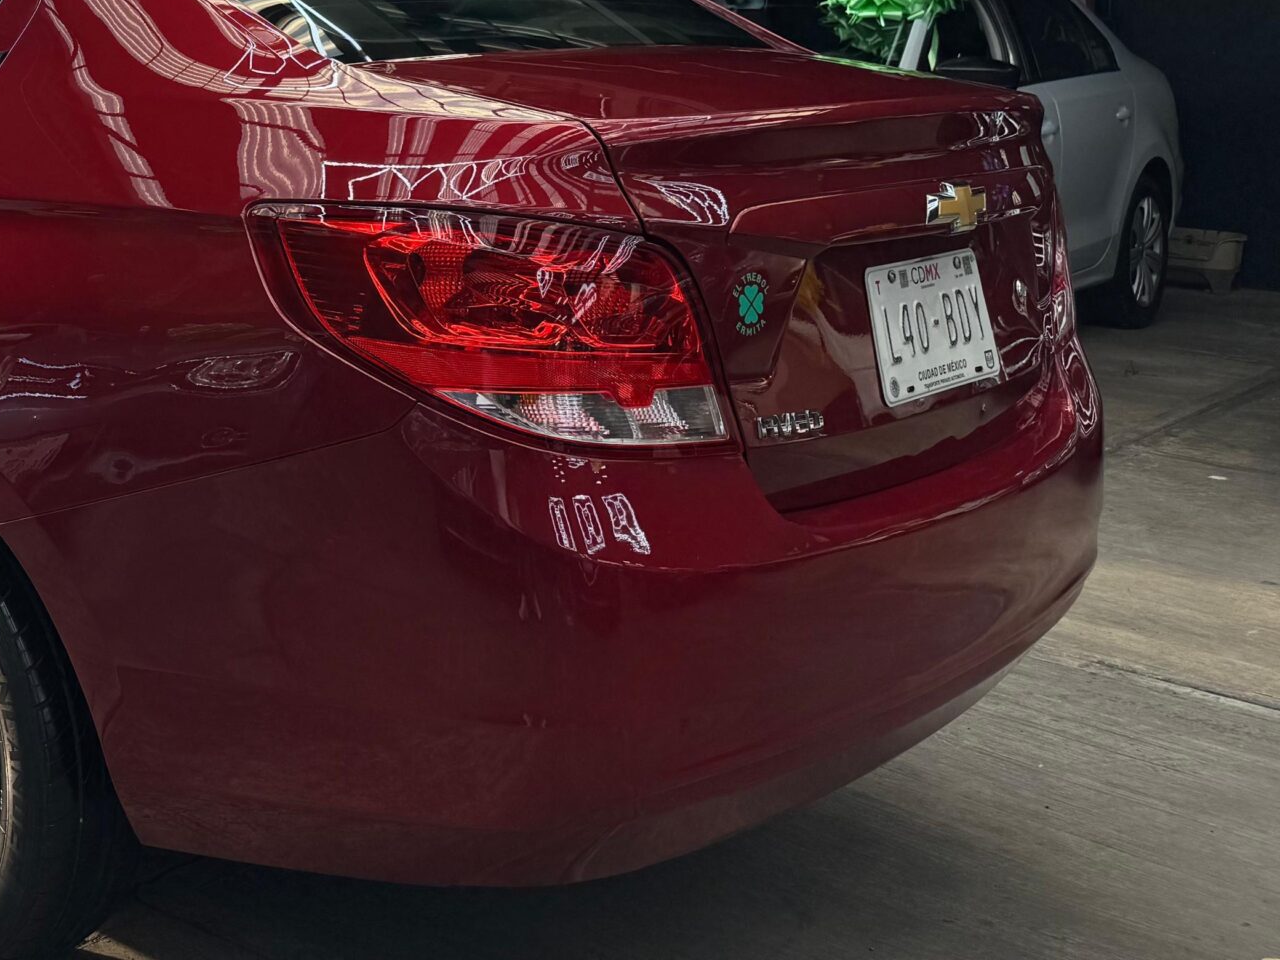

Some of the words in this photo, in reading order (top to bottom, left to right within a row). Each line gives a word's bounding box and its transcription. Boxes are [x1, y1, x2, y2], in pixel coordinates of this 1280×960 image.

[910, 262, 941, 285] CDMX
[732, 284, 743, 298] EL
[741, 271, 770, 295] TREBOL
[735, 319, 767, 337] ERMITA
[918, 366, 939, 382] CIUDAD
[938, 363, 948, 376] DE
